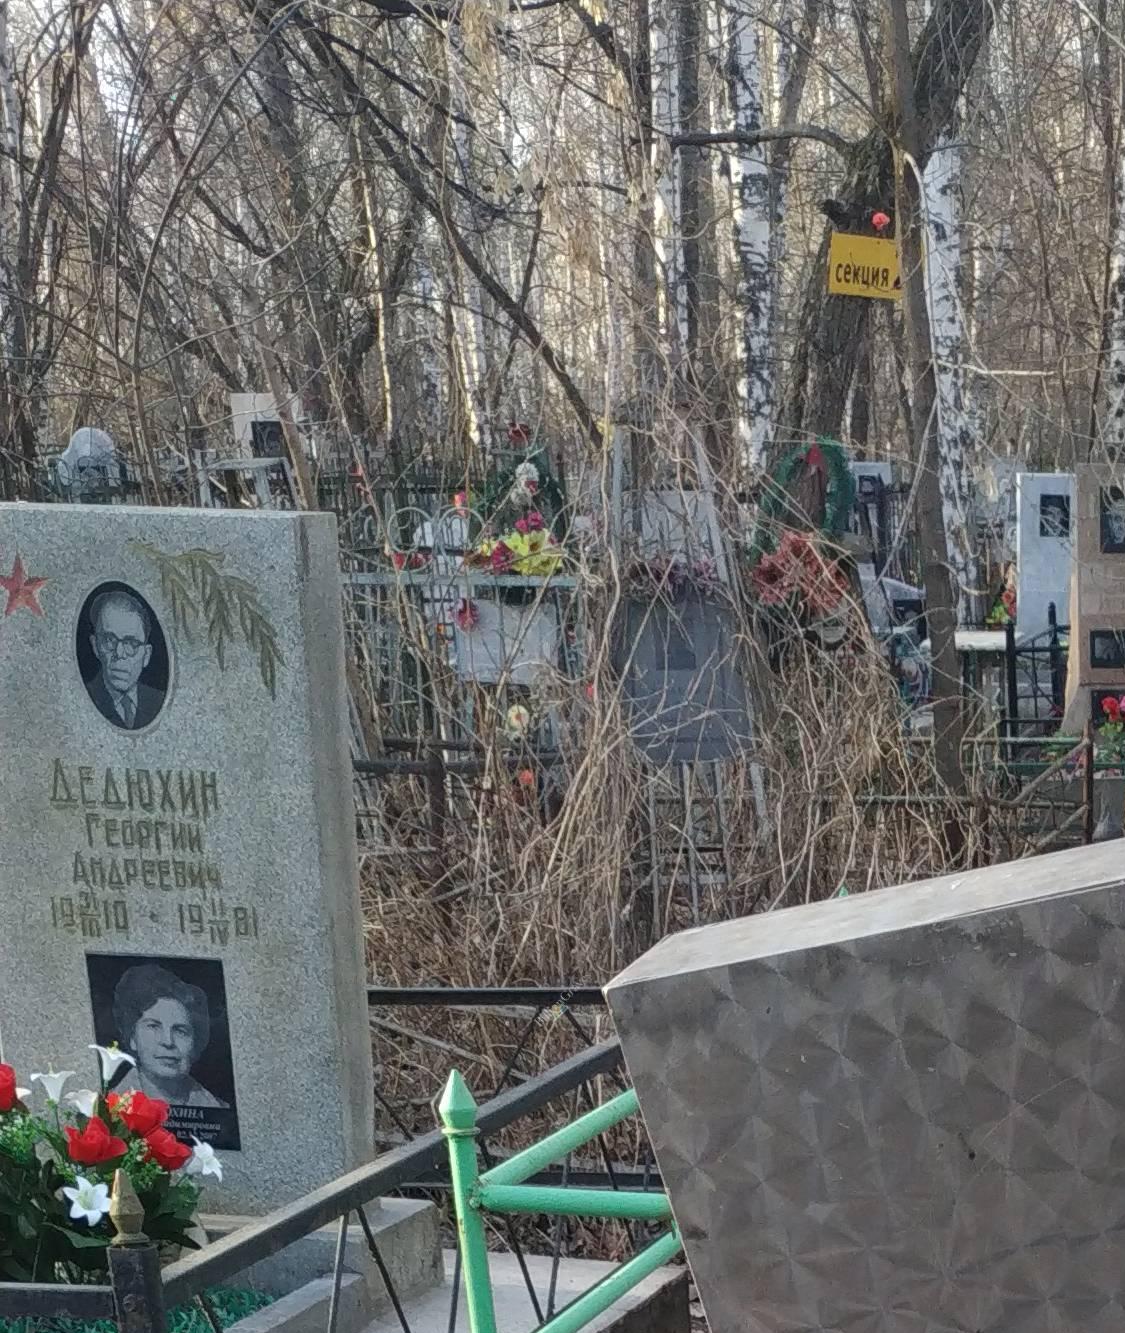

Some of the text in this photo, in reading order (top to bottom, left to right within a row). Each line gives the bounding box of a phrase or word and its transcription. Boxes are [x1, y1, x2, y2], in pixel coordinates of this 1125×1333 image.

[835, 262, 889, 288] секция
[50, 757, 220, 820] ДЕДЮХИН
[73, 850, 223, 892] АНДРЕЕВИЧ
